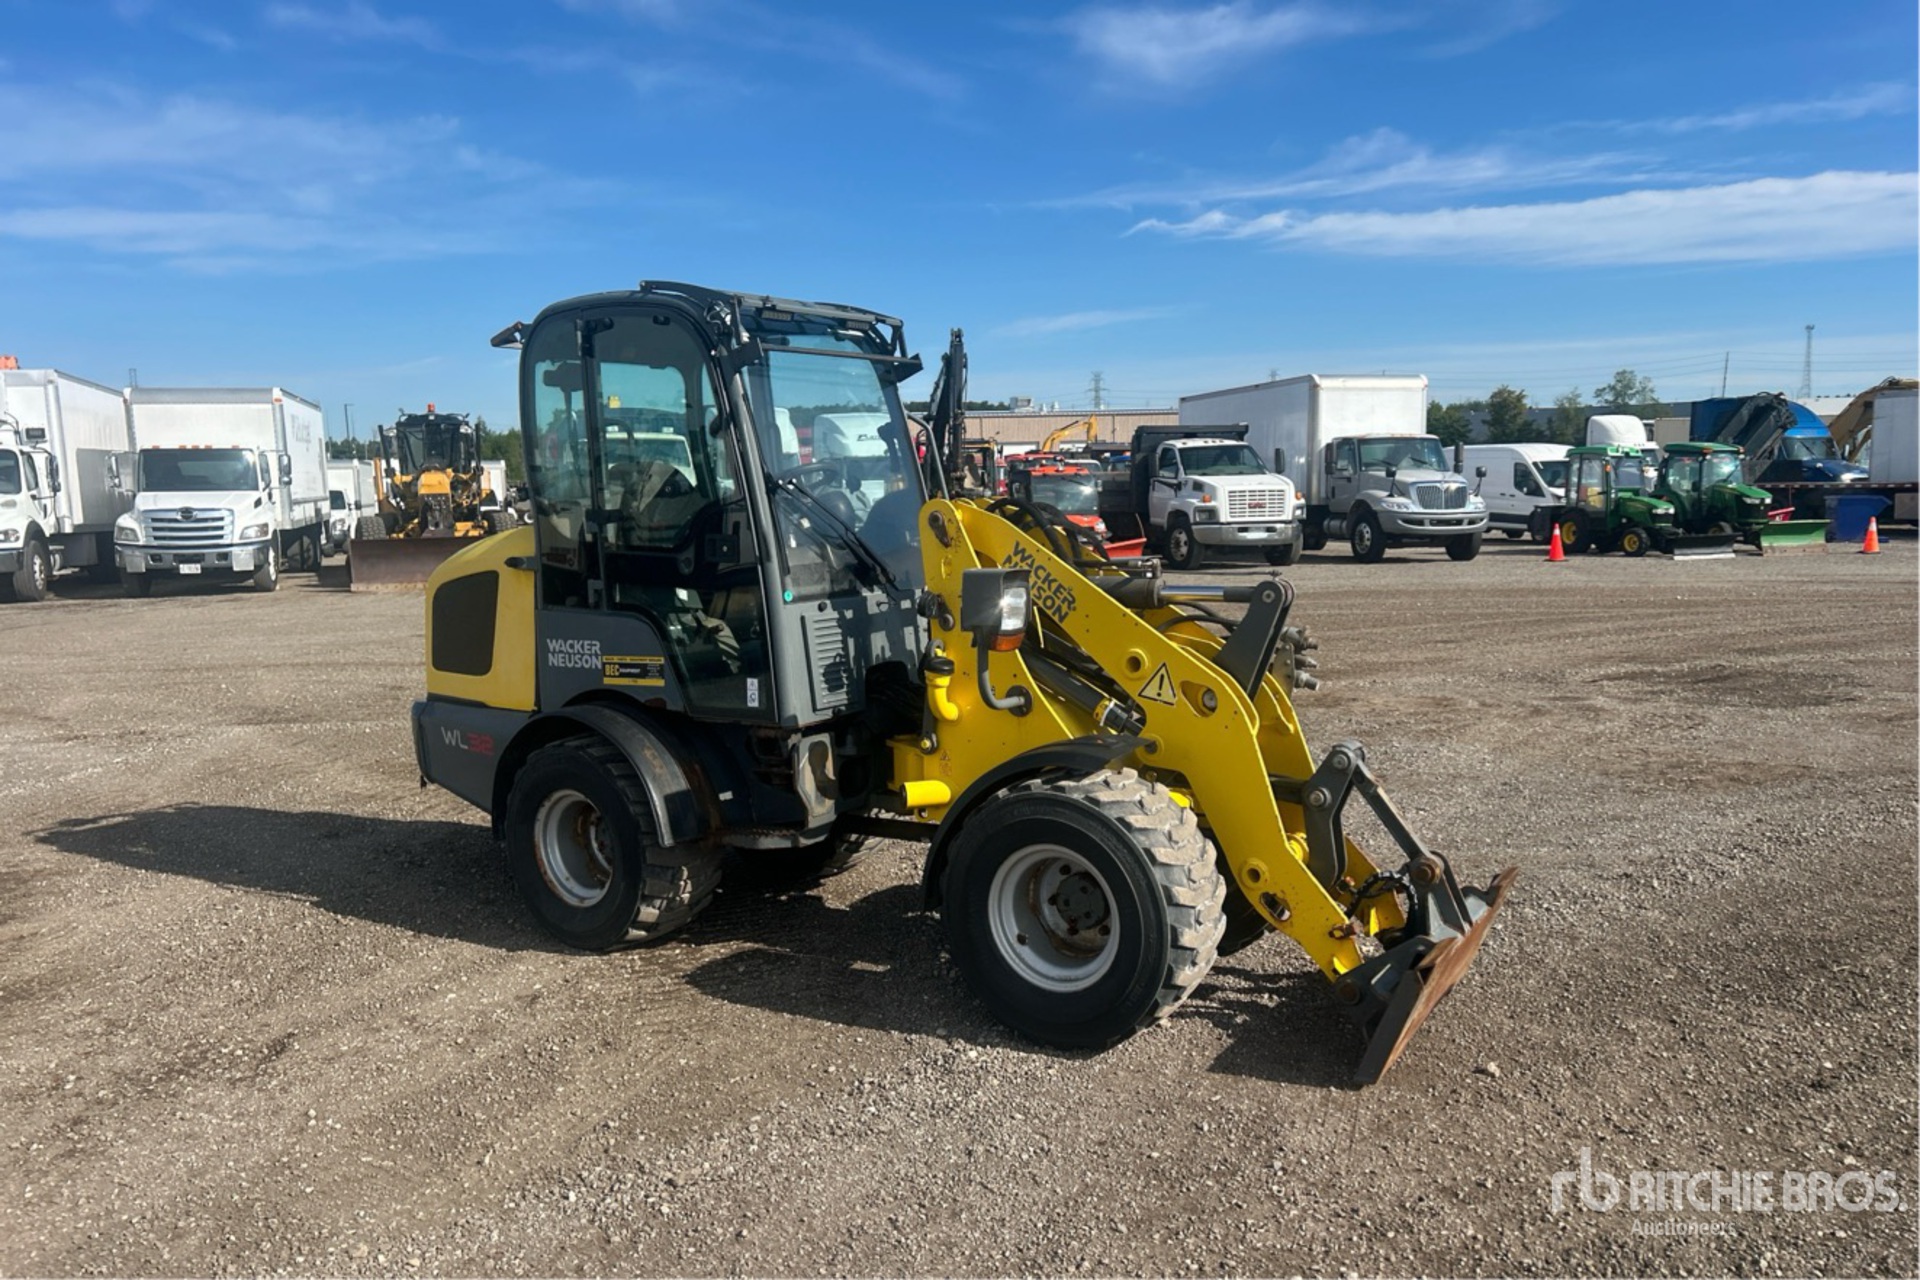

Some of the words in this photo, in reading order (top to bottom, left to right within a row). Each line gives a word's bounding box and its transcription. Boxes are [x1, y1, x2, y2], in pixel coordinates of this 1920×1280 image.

[1013, 540, 1076, 611] WACKER
[546, 638, 601, 655] WACKER
[548, 653, 602, 670] NEUSON
